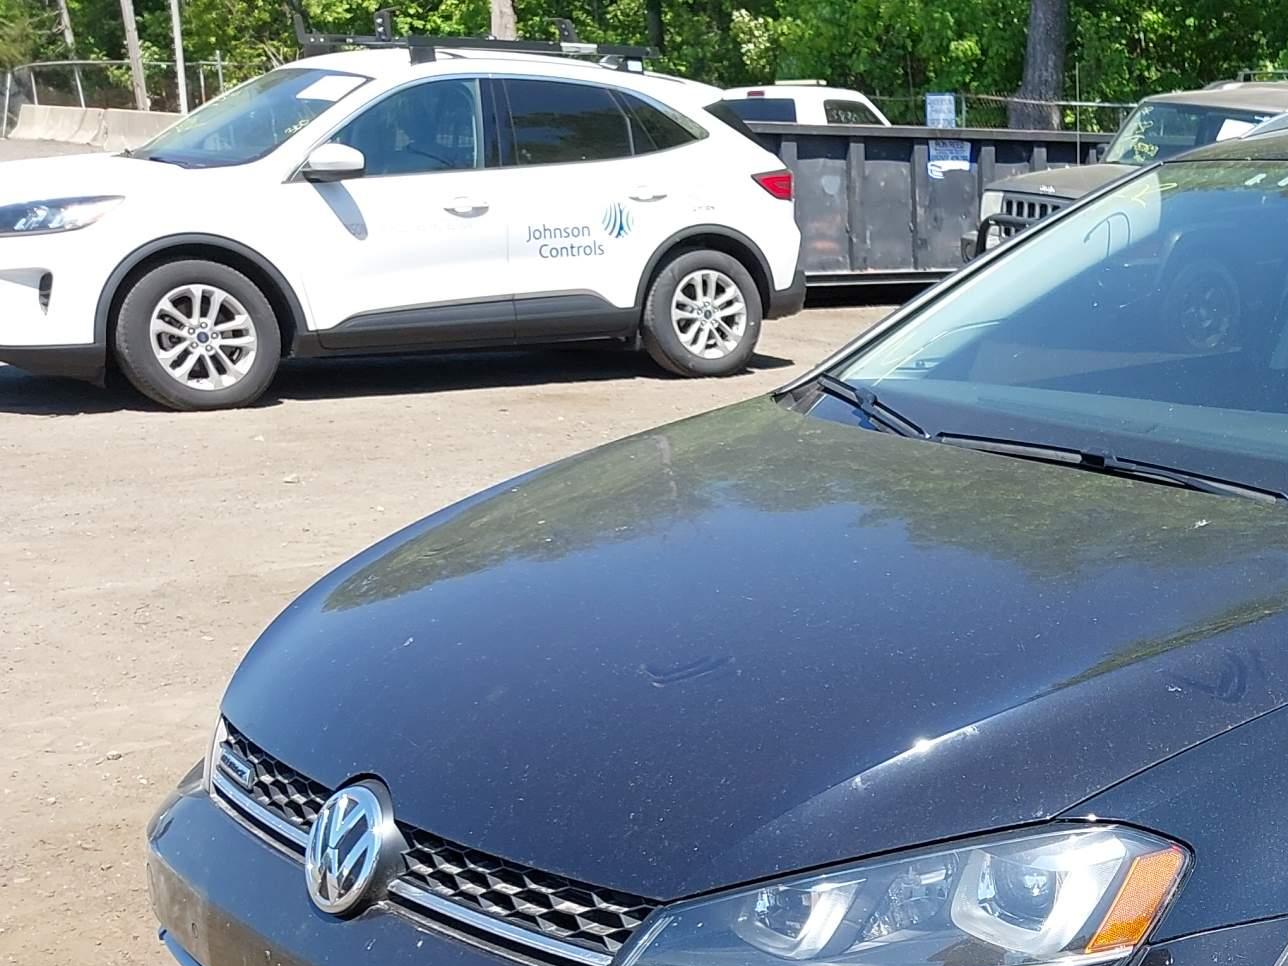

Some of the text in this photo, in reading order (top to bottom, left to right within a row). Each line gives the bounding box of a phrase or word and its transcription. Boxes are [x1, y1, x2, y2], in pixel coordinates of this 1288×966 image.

[526, 224, 591, 242] Johnson
[539, 240, 605, 259] Controls
[306, 786, 382, 912] VW
